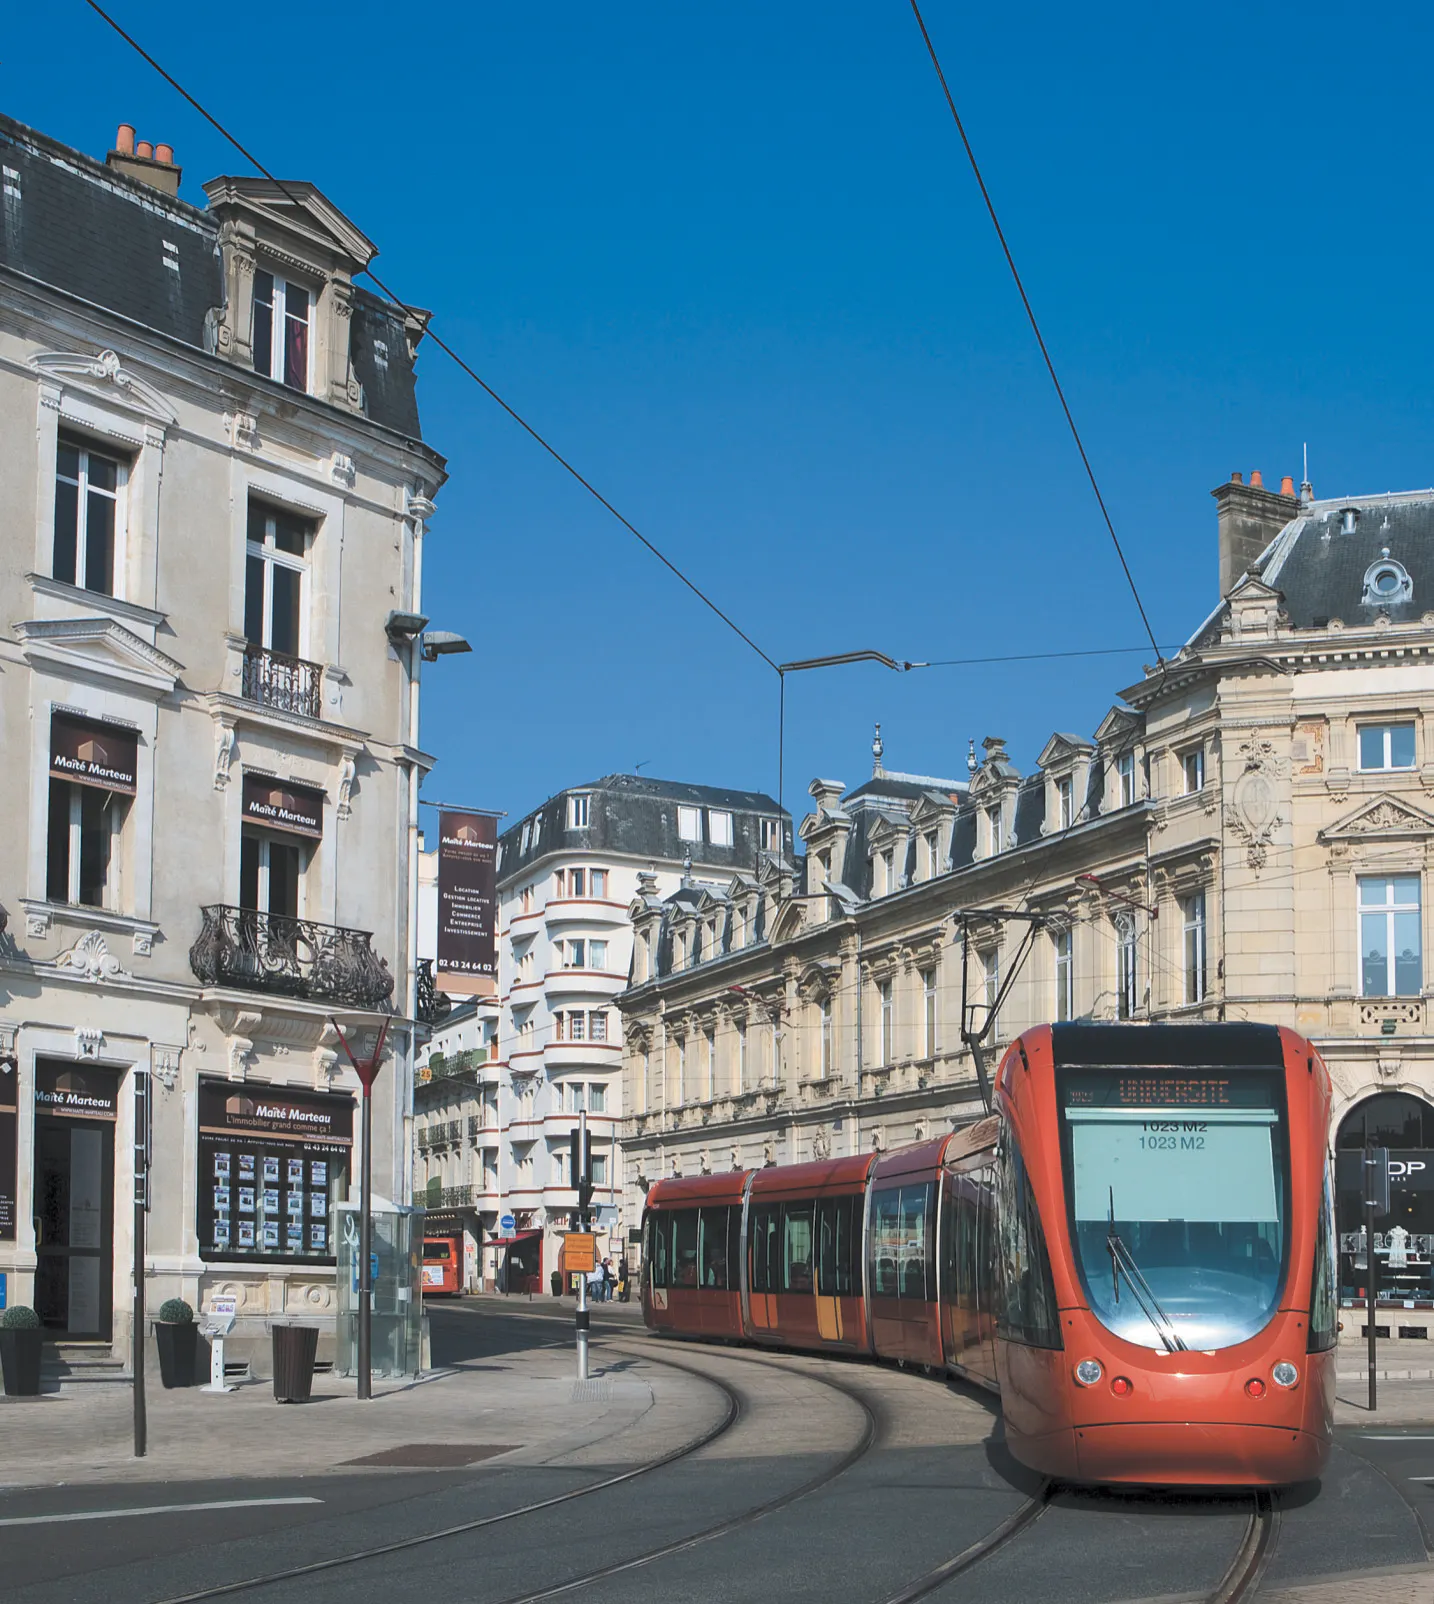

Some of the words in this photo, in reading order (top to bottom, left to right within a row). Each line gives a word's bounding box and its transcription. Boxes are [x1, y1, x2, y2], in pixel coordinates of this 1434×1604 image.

[54, 755, 86, 771] Maïté
[88, 763, 132, 782] Marteau
[249, 801, 277, 816] Maïté
[278, 808, 316, 826] Marteau
[464, 839, 494, 850] Marteau
[439, 959, 448, 967] 02
[450, 960, 459, 968] 43
[461, 961, 470, 969] 24
[472, 962, 481, 970] 64
[483, 963, 492, 972] 02
[35, 1090, 64, 1103] Maïté
[66, 1094, 111, 1107] Marteau
[256, 1105, 287, 1119] Maïté
[288, 1109, 331, 1123] Marteau
[226, 1115, 270, 1127] L'immobilier
[272, 1121, 291, 1130] grand
[293, 1124, 318, 1132] comme
[1142, 1121, 1179, 1132] 1023
[1183, 1121, 1208, 1132] M2
[1139, 1136, 1177, 1150] 1023
[1180, 1136, 1205, 1150] M2
